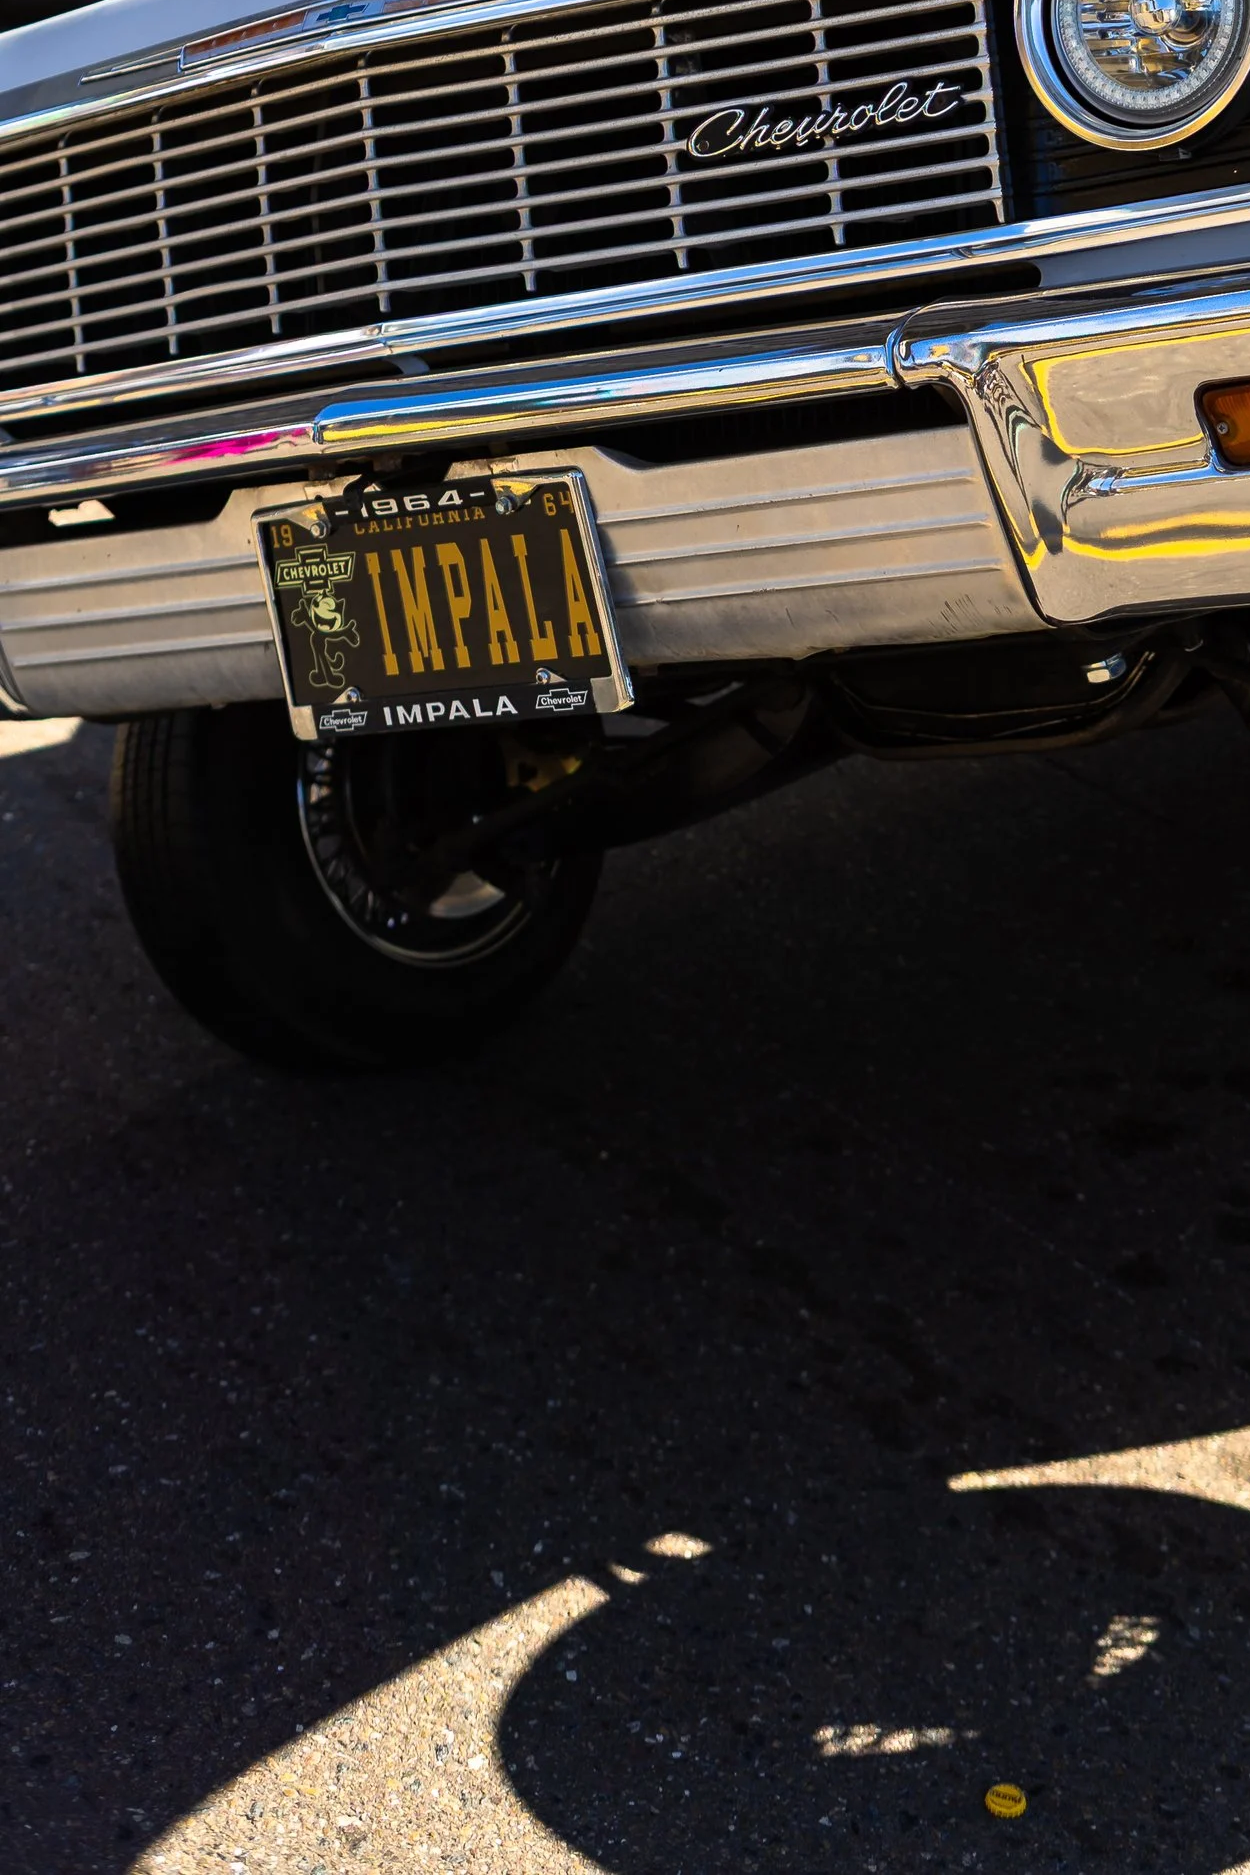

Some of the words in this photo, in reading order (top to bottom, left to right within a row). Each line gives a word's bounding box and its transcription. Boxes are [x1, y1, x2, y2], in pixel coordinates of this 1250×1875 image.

[688, 82, 961, 157] Chevrolet
[271, 524, 294, 549] 19
[544, 490, 574, 517] 64
[283, 561, 346, 581] CHEVROLET
[366, 528, 602, 676] IMPALA
[323, 714, 363, 727] Chevrolet
[383, 695, 518, 726] IMPALA
[540, 693, 583, 706] Chevrolet
